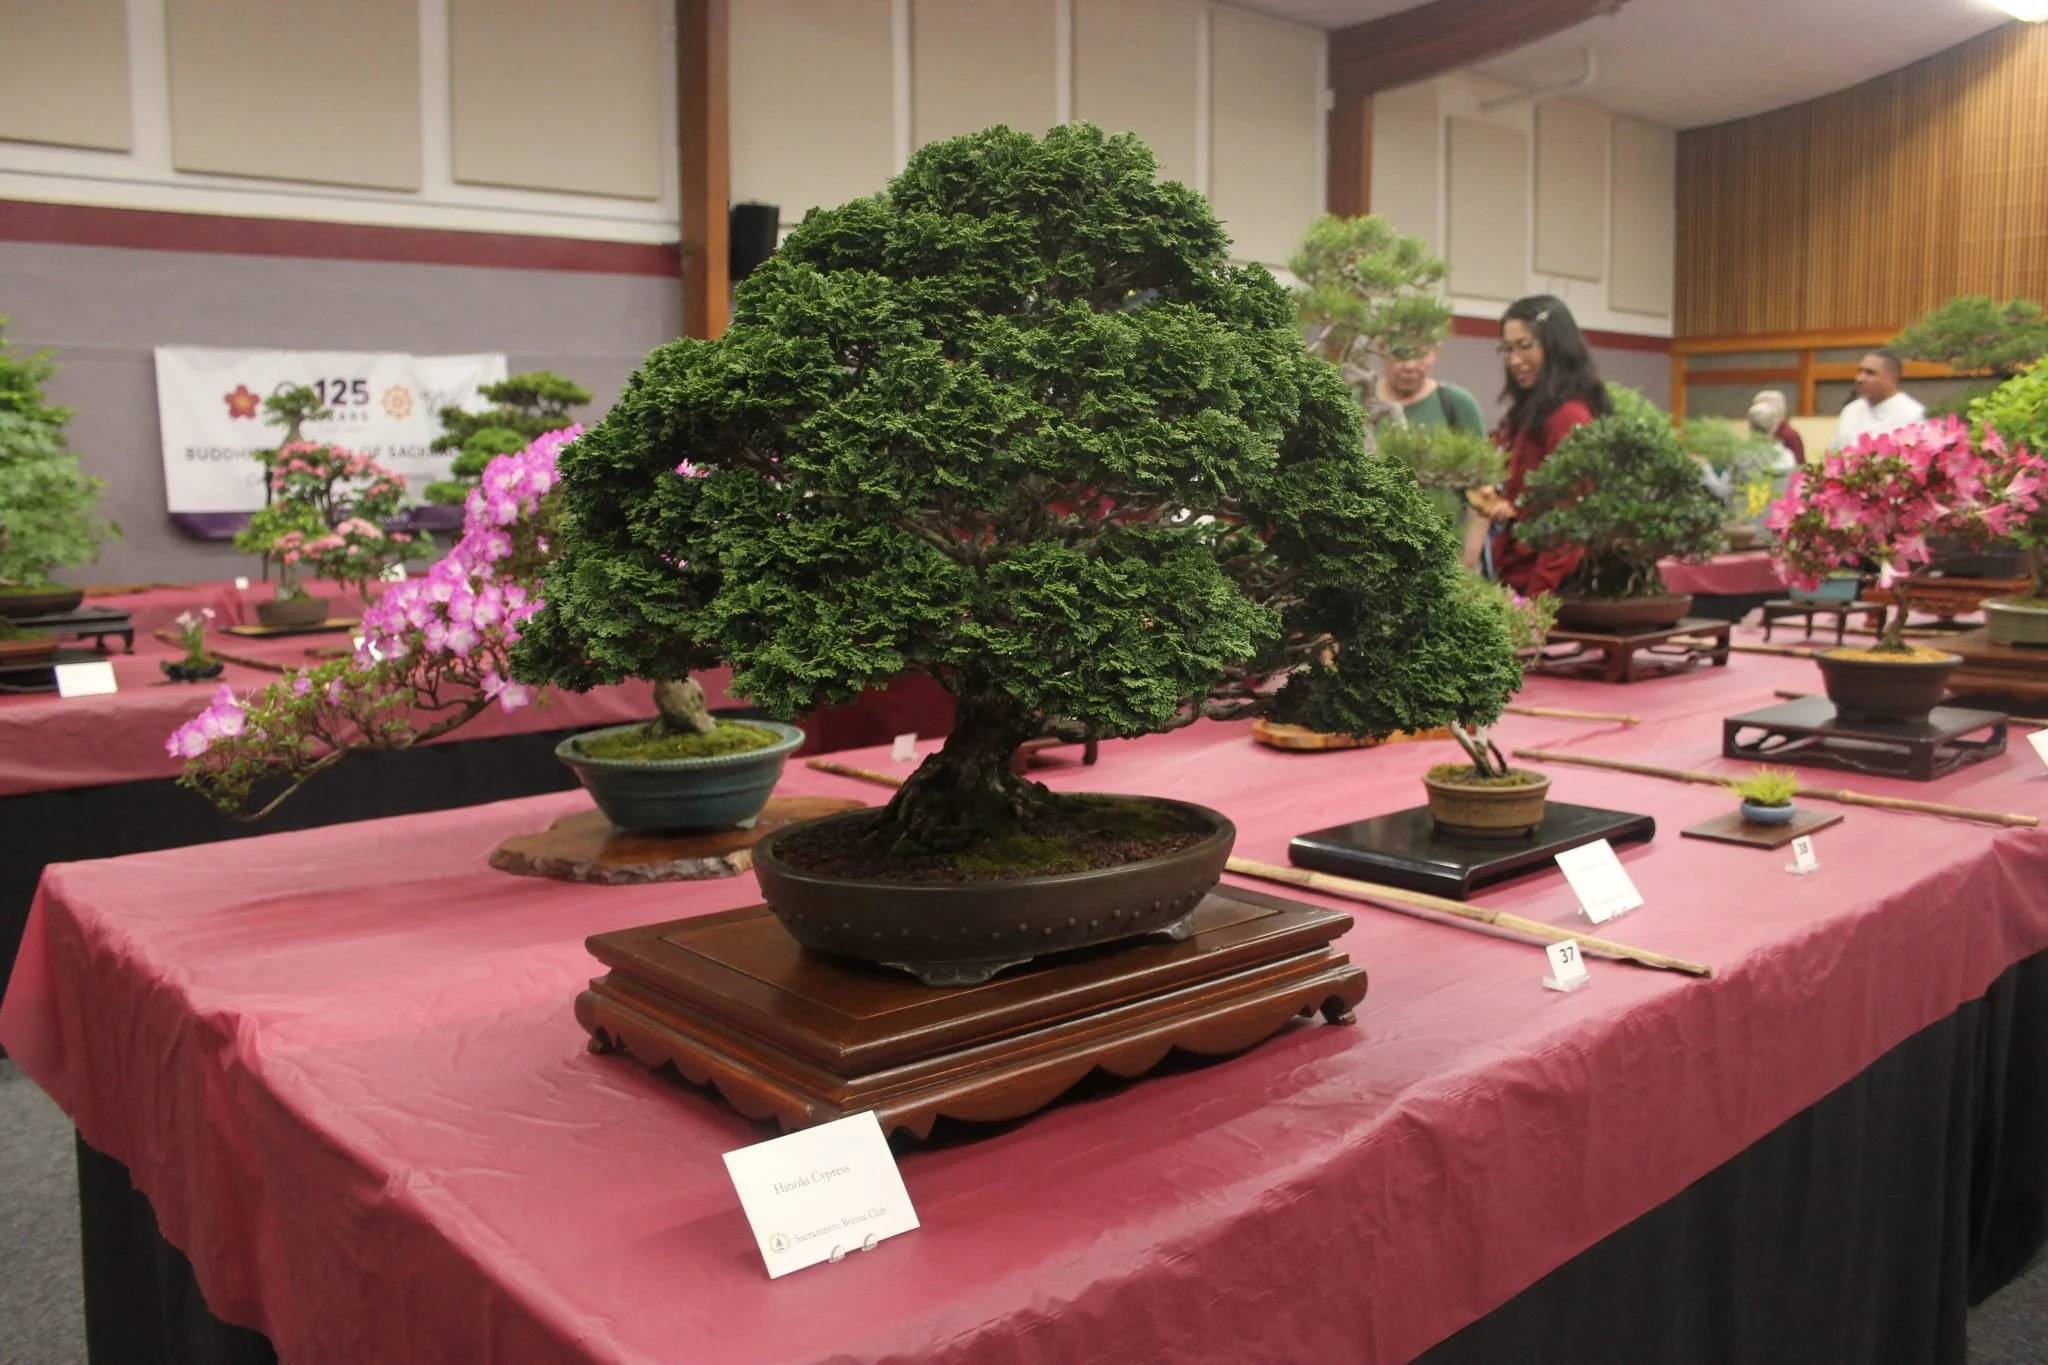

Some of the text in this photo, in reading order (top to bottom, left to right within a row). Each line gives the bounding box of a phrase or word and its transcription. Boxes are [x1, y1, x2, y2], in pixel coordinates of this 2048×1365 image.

[314, 379, 370, 405] 125
[1559, 946, 1574, 963] 37
[773, 1165, 850, 1195] Hinoki Cypress
[794, 1223, 841, 1243] Sacramento
[868, 1206, 887, 1218] Club
